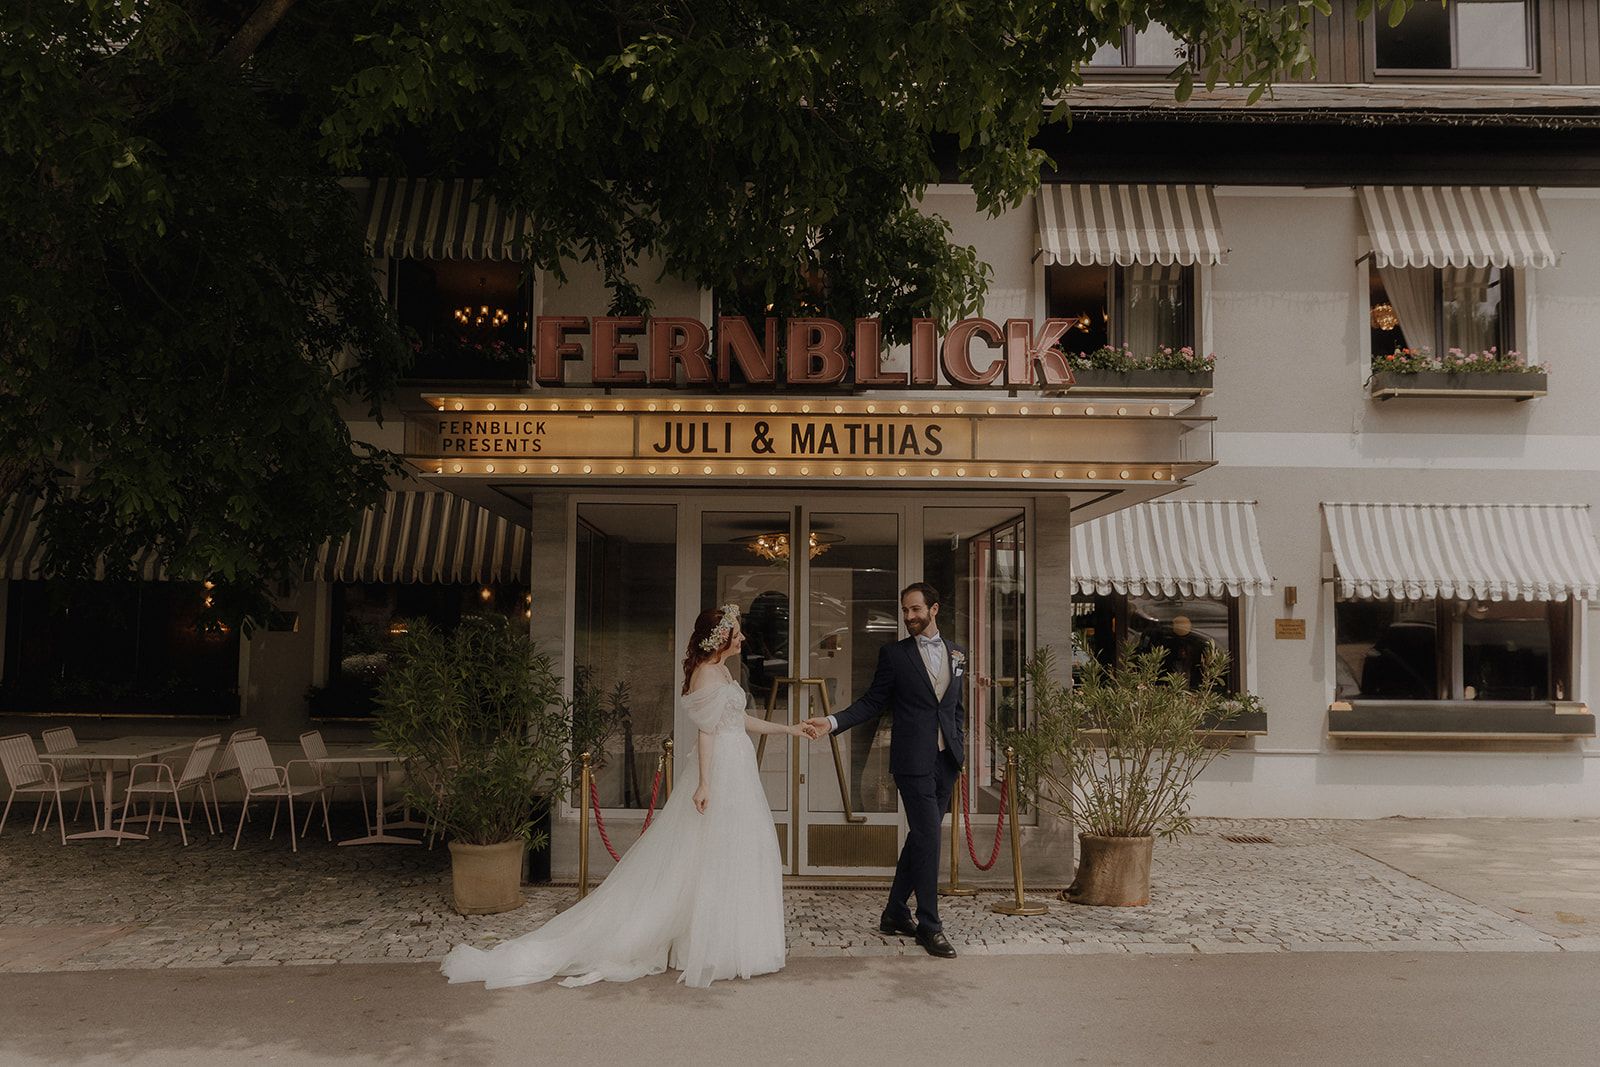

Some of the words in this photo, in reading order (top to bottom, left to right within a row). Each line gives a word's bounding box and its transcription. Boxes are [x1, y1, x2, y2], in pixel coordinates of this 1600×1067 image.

[536, 316, 1077, 388] FERNBLICK
[438, 421, 546, 435] FERNBLICK
[653, 422, 731, 453] JULI
[751, 421, 775, 454] &
[791, 423, 942, 456] MATHIAS
[442, 438, 542, 452] PRESENTS
